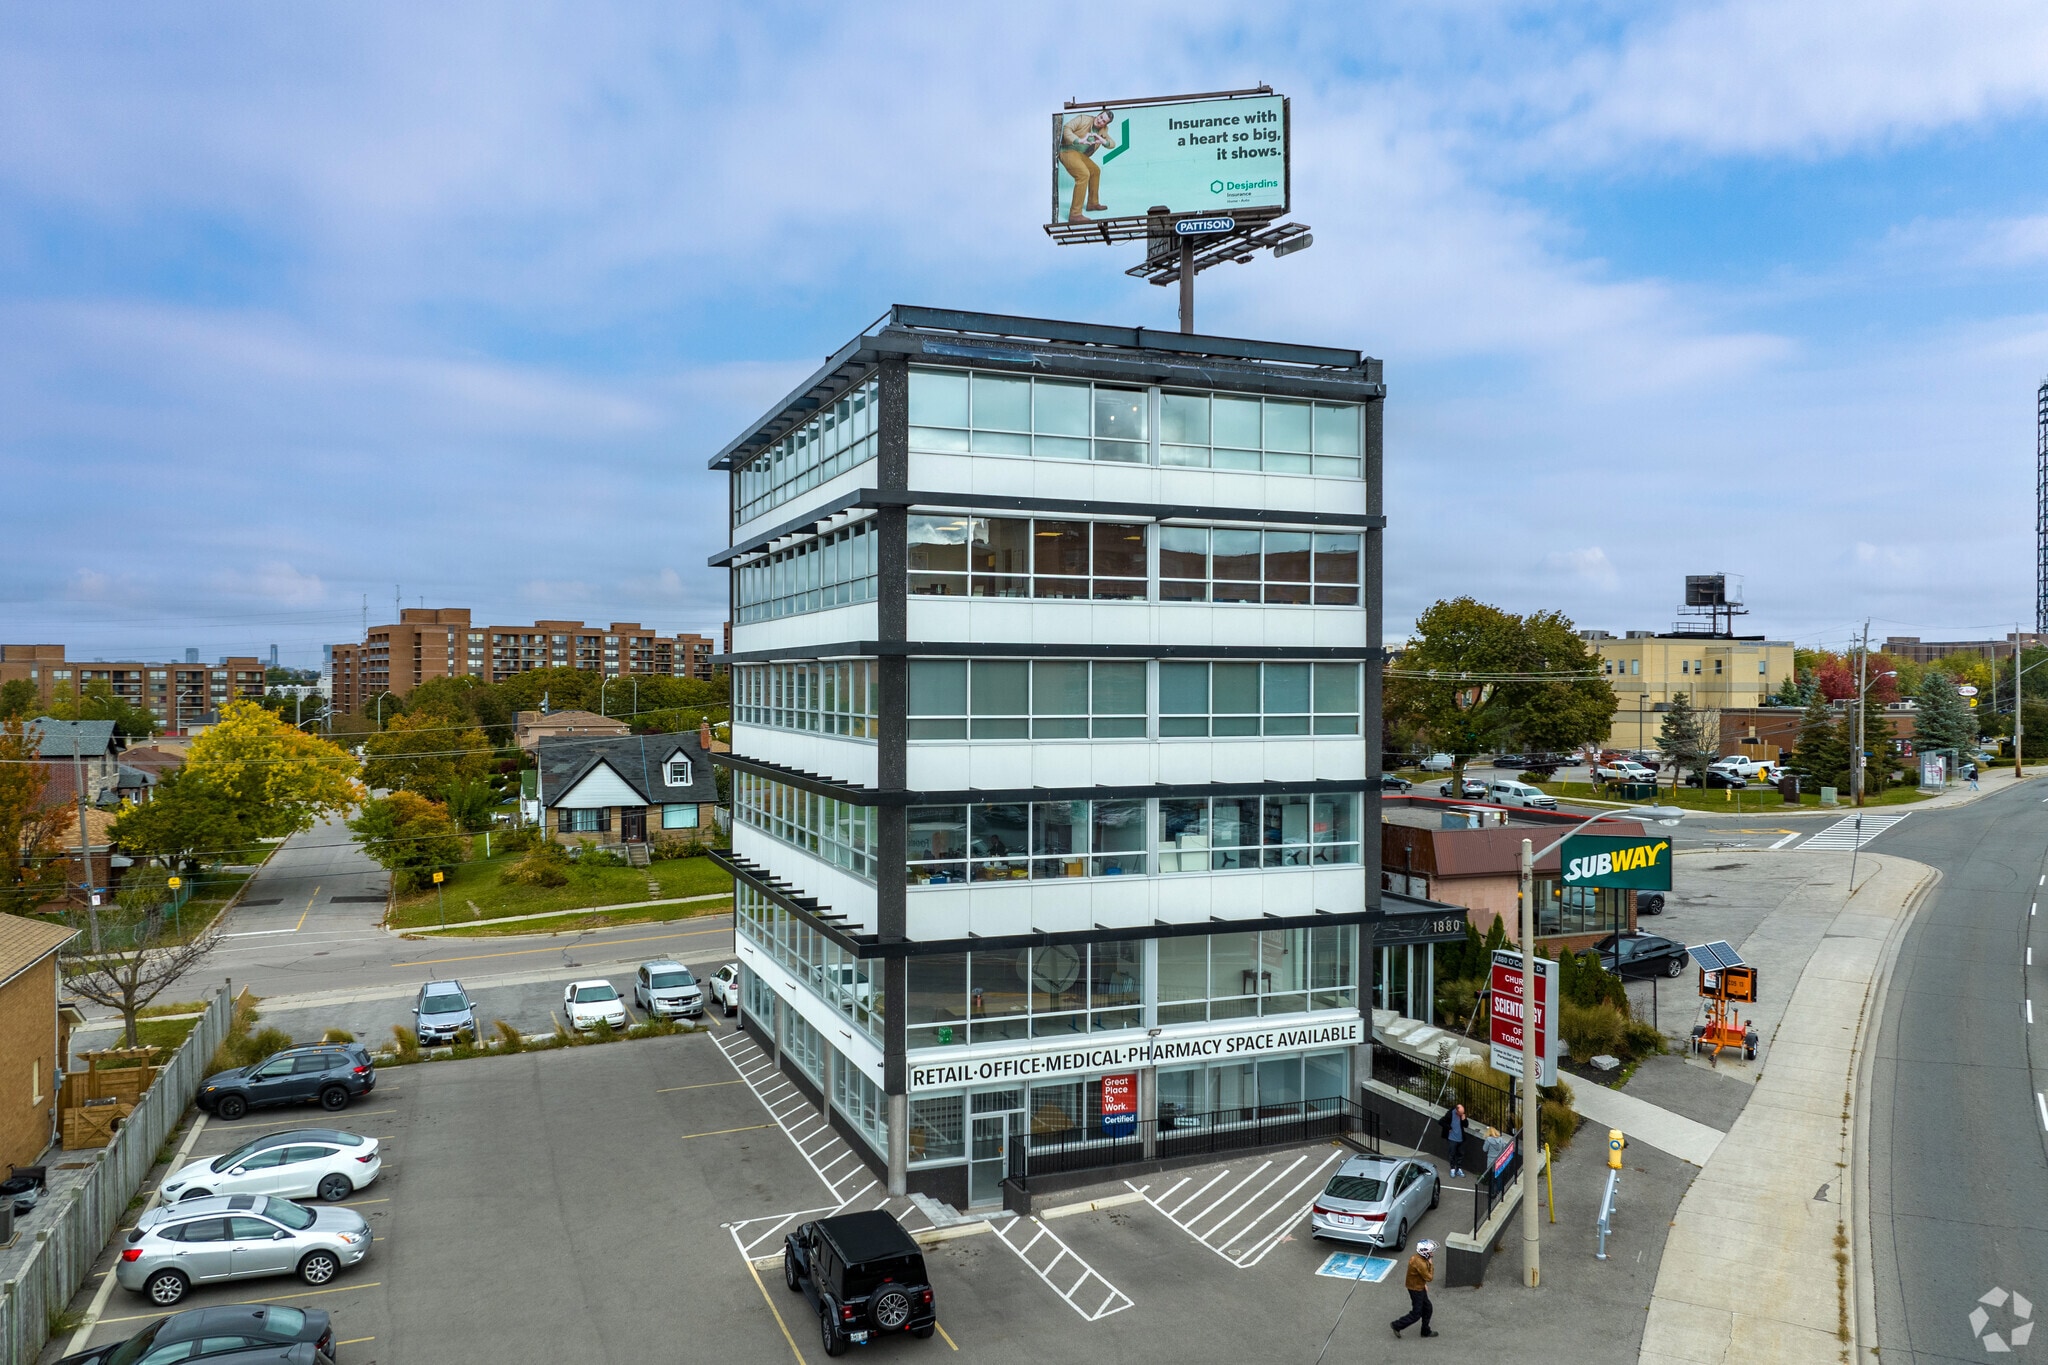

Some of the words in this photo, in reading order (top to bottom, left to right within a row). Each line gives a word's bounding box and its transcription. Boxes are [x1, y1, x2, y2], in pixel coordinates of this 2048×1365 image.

[1169, 116, 1240, 130] Insurance
[1244, 110, 1277, 124] with
[1178, 137, 1185, 146] a
[1190, 132, 1228, 145] heart
[1232, 132, 1249, 142] so
[1253, 128, 1281, 142] big,
[1217, 148, 1227, 160] it
[1231, 146, 1281, 159] shows.
[1227, 180, 1278, 191] Desjardins
[1180, 220, 1230, 231] PATTISON
[1563, 841, 1668, 882] SUBWAY
[1433, 920, 1460, 933] 1880
[1504, 974, 1523, 986] CHUR
[1514, 986, 1523, 994] OF
[1494, 996, 1542, 1024] SCIENTOGY
[1513, 1027, 1522, 1035] OF
[1226, 1034, 1273, 1053] SPACE
[1278, 1025, 1356, 1047] AVAILABLE
[1501, 1032, 1523, 1046] TORON
[1105, 1078, 1128, 1086] Great
[1105, 1086, 1128, 1094] Place
[1105, 1095, 1114, 1103] To
[1105, 1114, 1134, 1124] Certified
